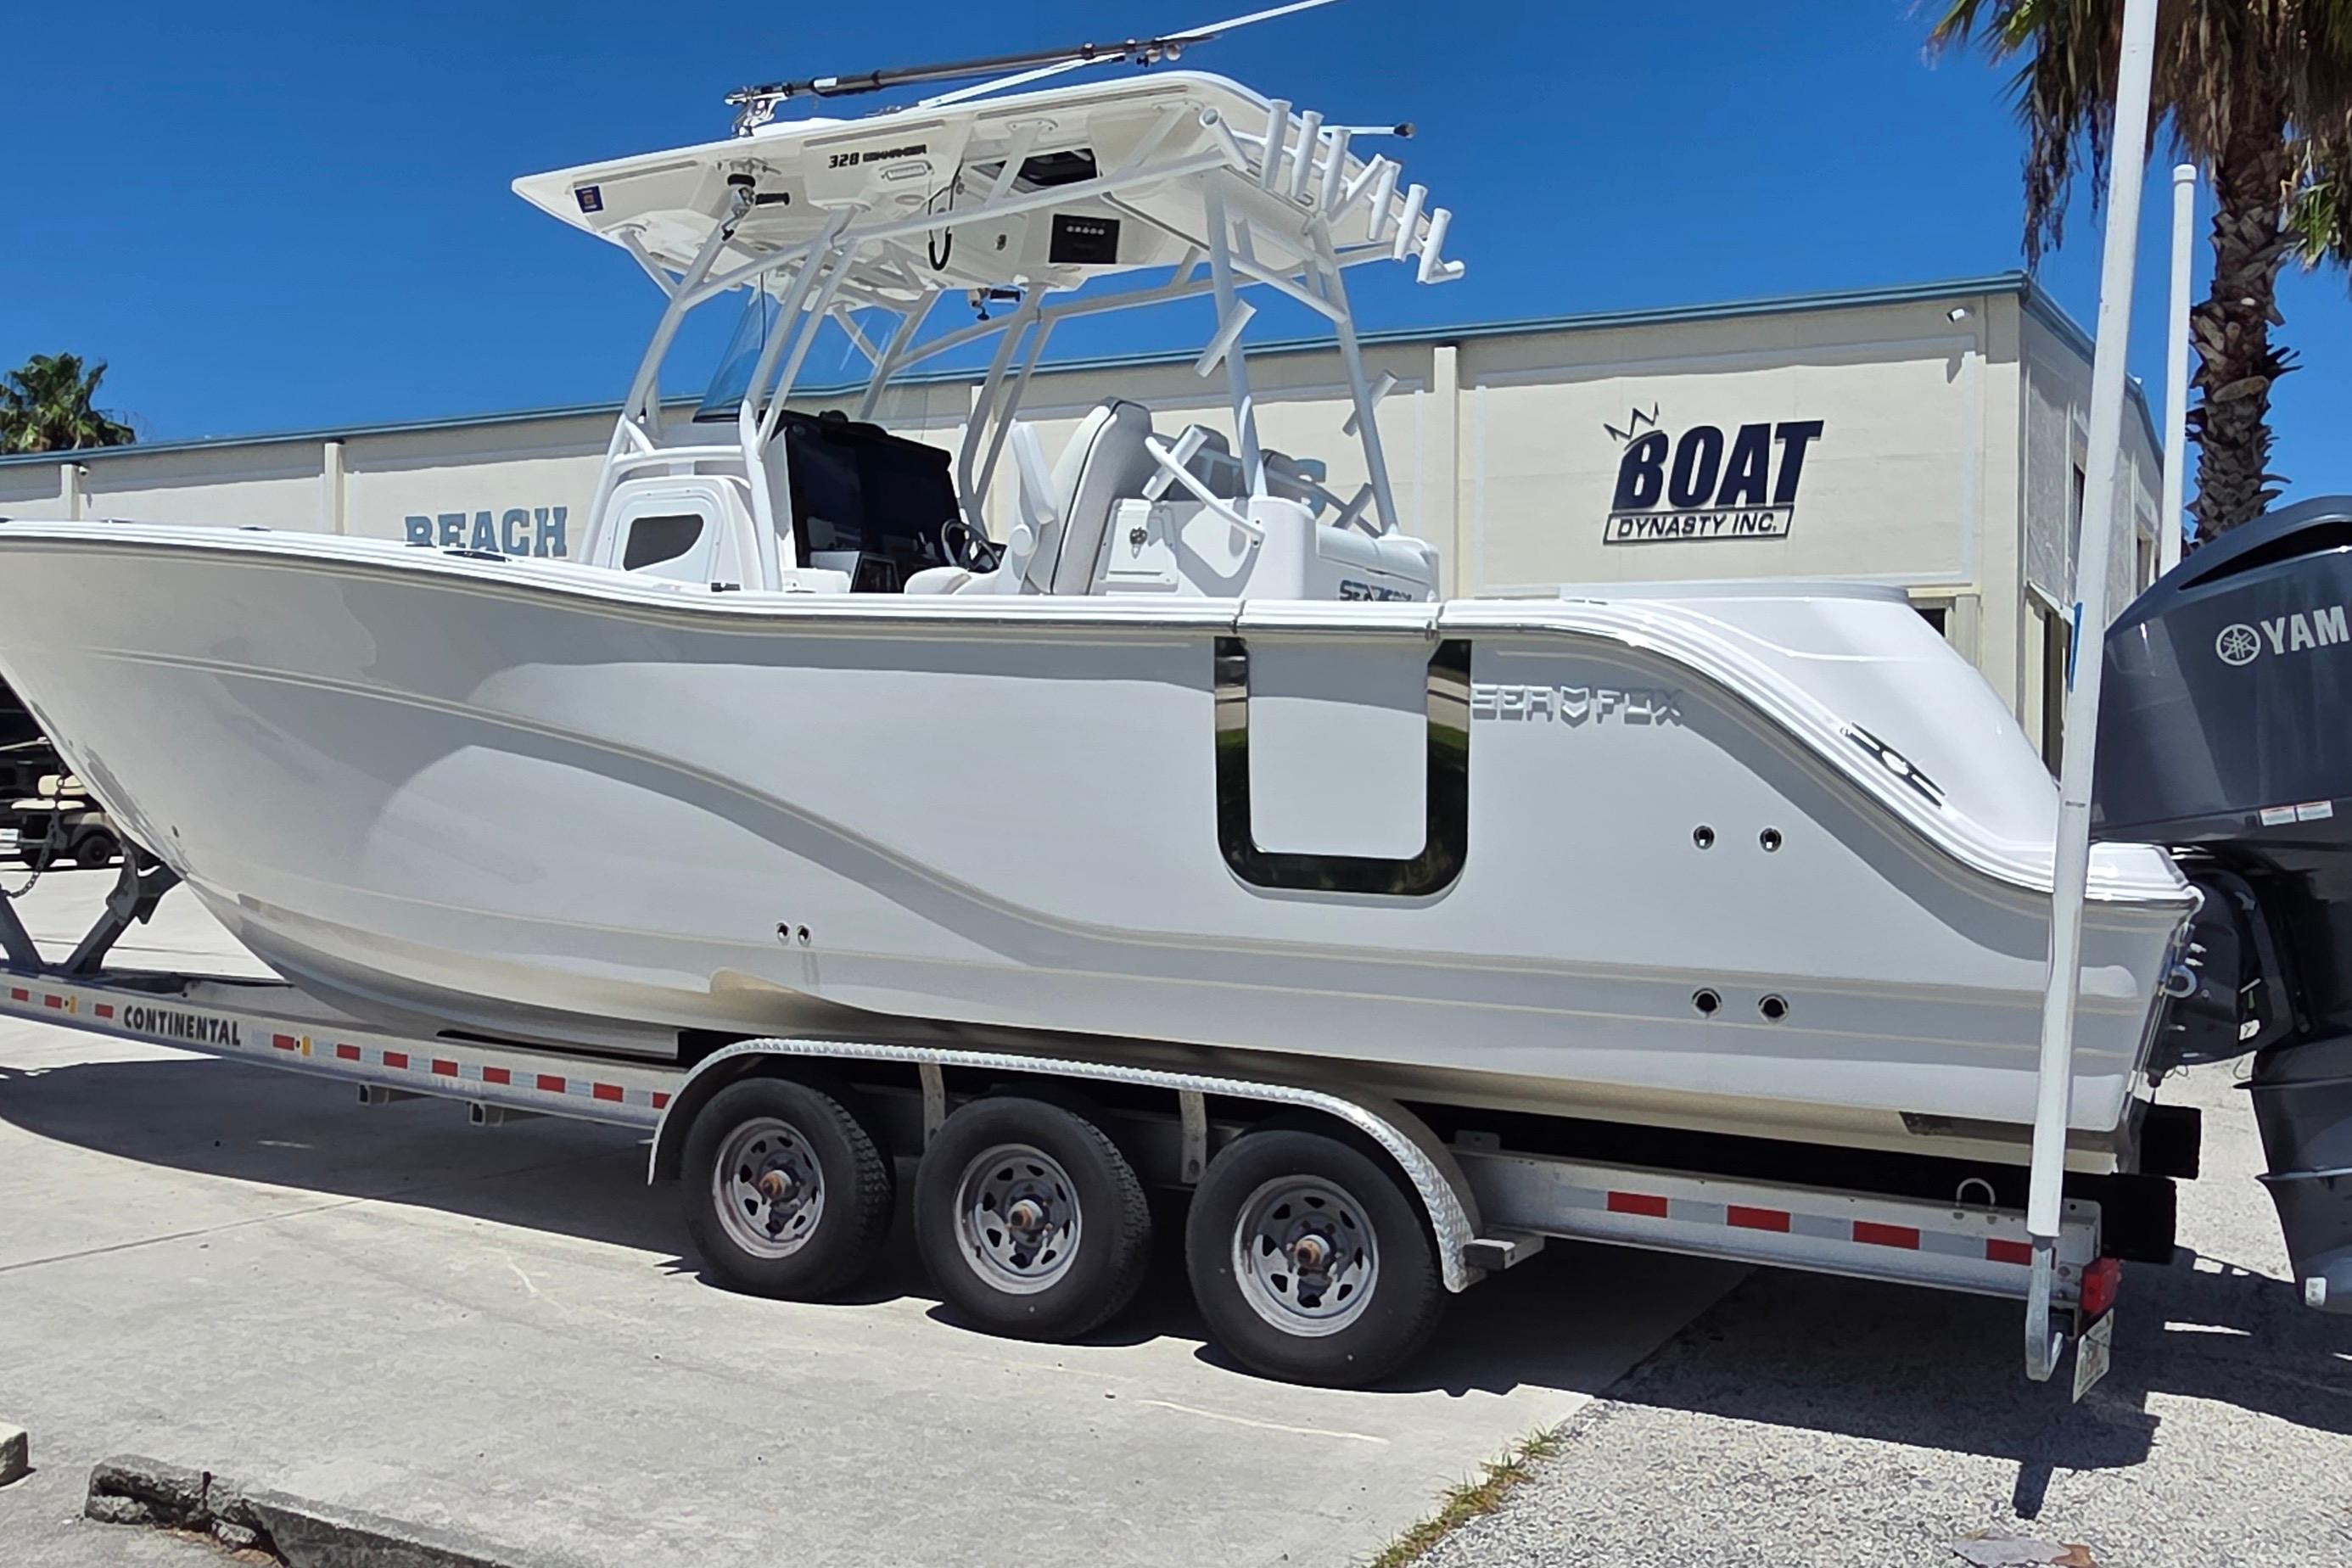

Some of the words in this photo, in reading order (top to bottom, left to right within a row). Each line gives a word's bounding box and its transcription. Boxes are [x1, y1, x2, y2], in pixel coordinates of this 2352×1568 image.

[1612, 419, 1824, 510] BOAT
[404, 506, 567, 557] BEACH
[1616, 513, 1728, 539] DYNASTY
[1732, 512, 1778, 535] INC.
[2260, 604, 2350, 656] YAM
[1470, 682, 1554, 721] SEA
[123, 1005, 241, 1046] CONTINENTAL
